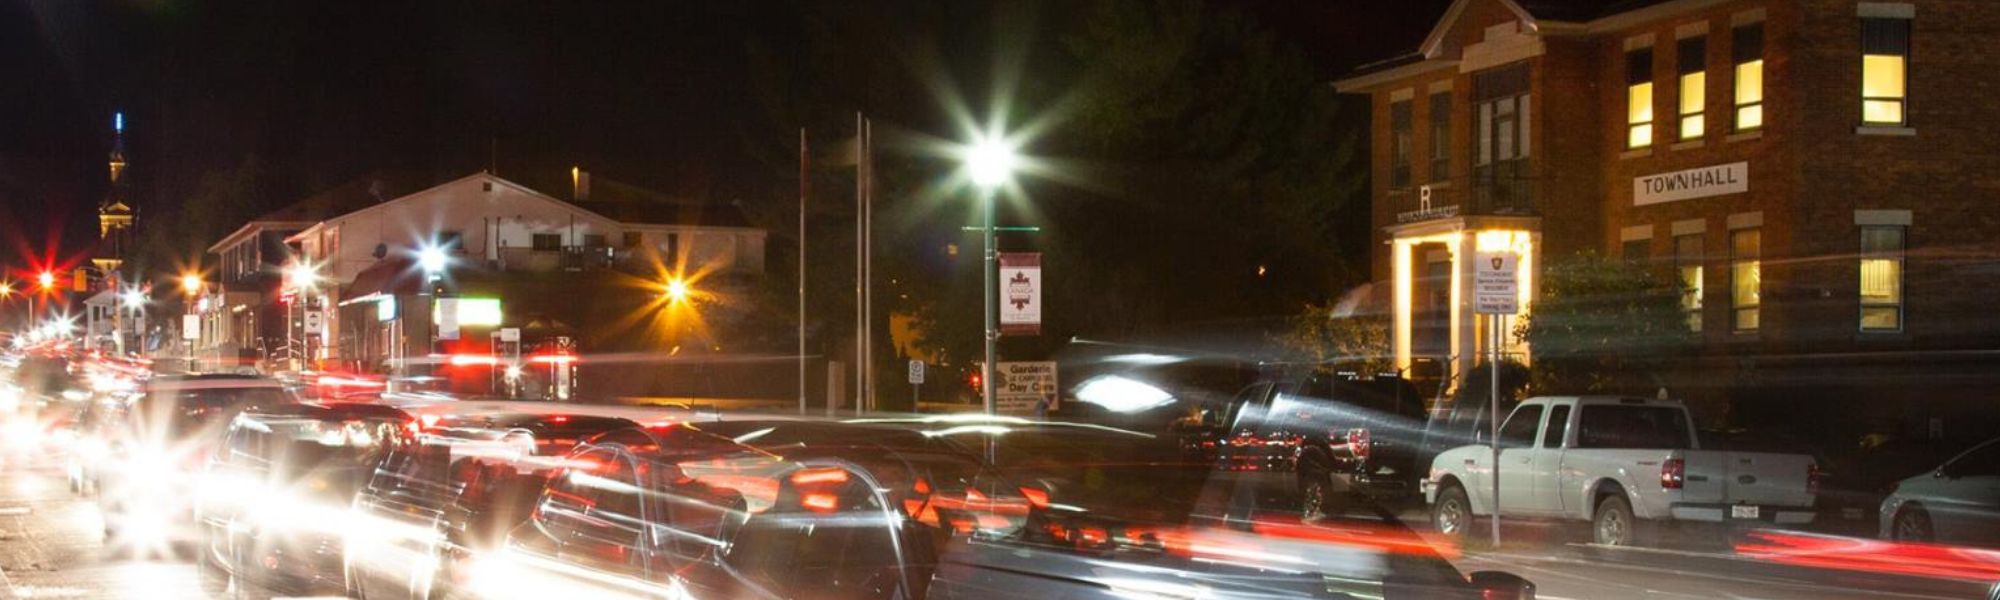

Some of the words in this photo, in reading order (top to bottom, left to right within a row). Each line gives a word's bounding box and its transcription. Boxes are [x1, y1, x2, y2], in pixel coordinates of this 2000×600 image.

[1420, 185, 1431, 213] R
[1010, 364, 1051, 374] Garderie
[1009, 383, 1028, 393] Day
